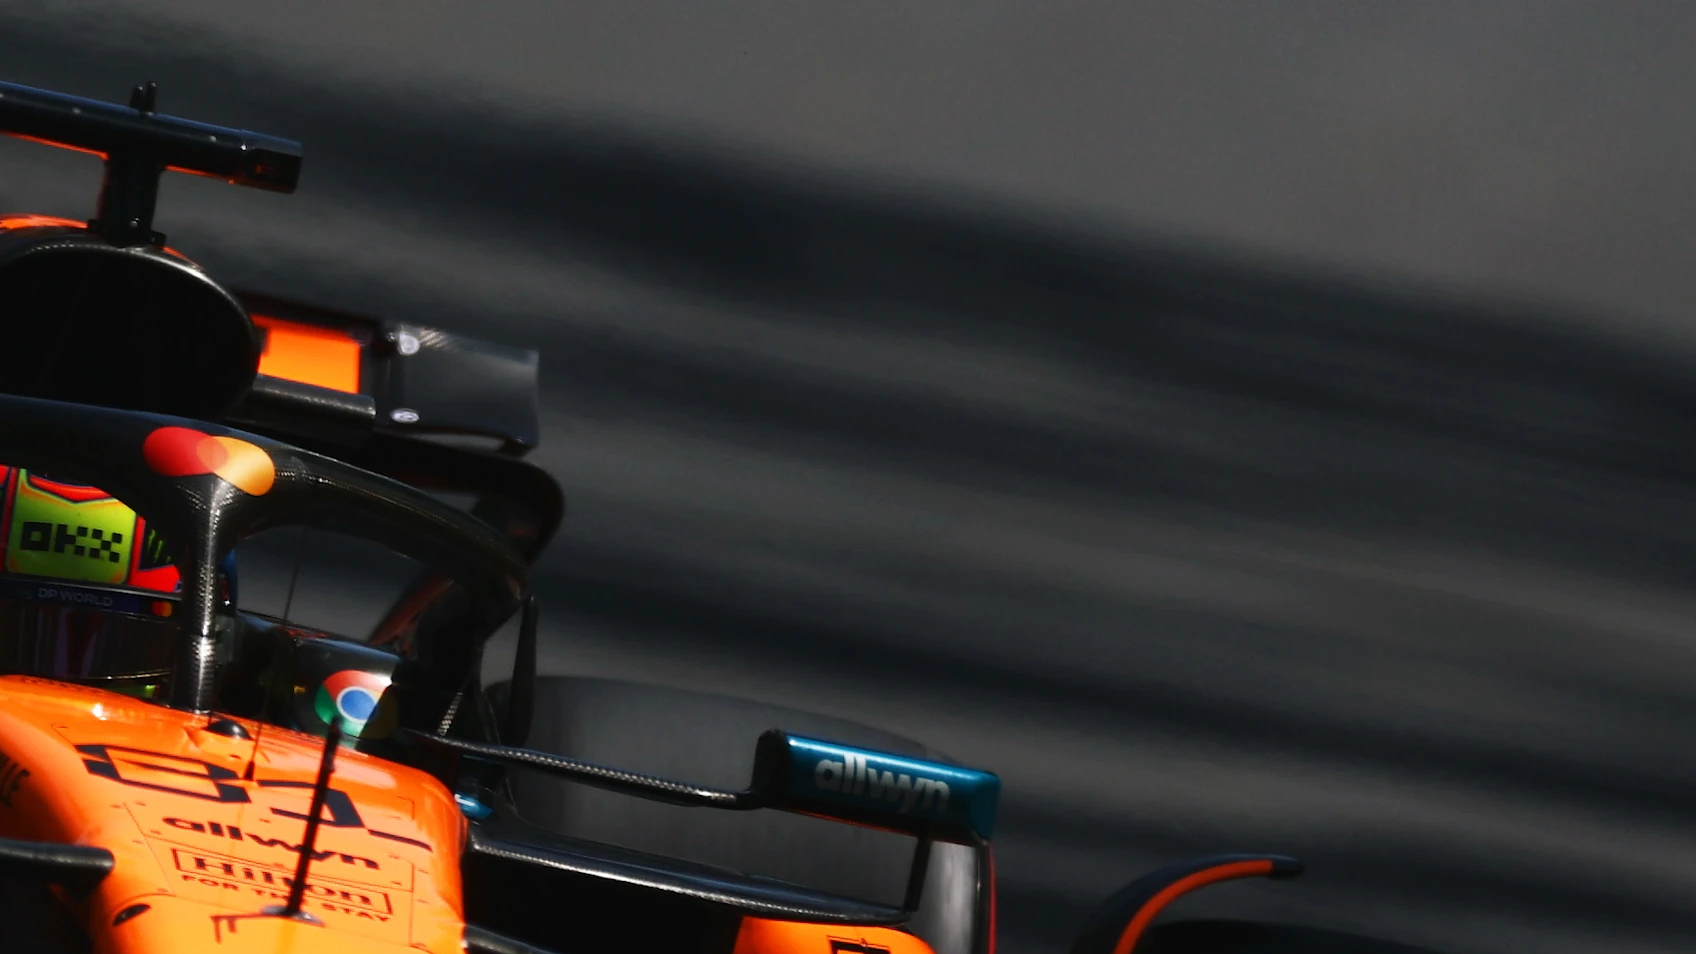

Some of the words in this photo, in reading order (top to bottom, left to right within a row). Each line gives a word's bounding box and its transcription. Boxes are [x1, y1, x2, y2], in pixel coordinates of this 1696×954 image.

[20, 521, 123, 563] OKX
[38, 587, 58, 600] DP
[60, 590, 114, 607] WORLD
[813, 755, 951, 815] allwyn
[181, 874, 240, 892] FOR
[321, 902, 392, 922] STAY
